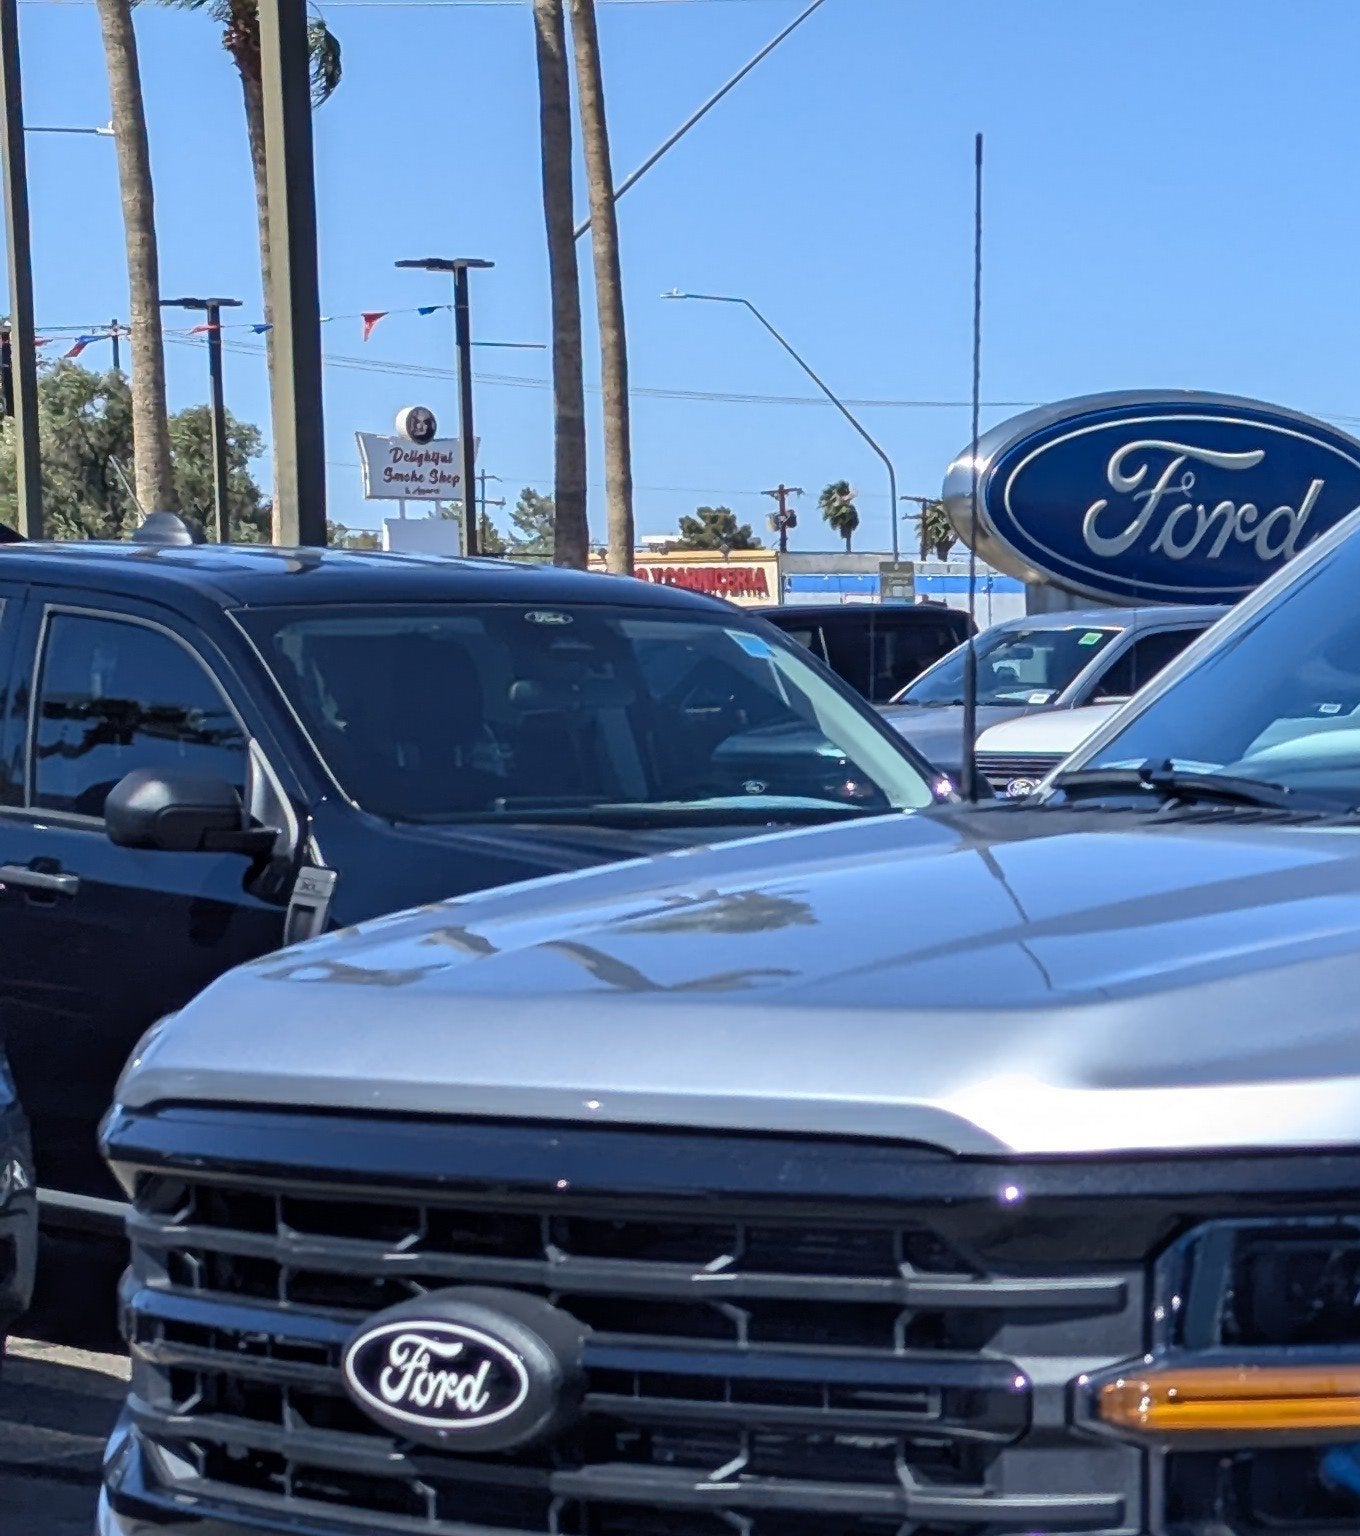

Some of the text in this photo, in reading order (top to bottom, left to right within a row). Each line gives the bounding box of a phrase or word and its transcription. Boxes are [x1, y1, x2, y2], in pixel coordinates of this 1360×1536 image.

[382, 466, 461, 488] Smoke Shop
[389, 446, 453, 467] Delightful
[1083, 439, 1325, 560] Ford
[380, 1334, 491, 1413] Ford
